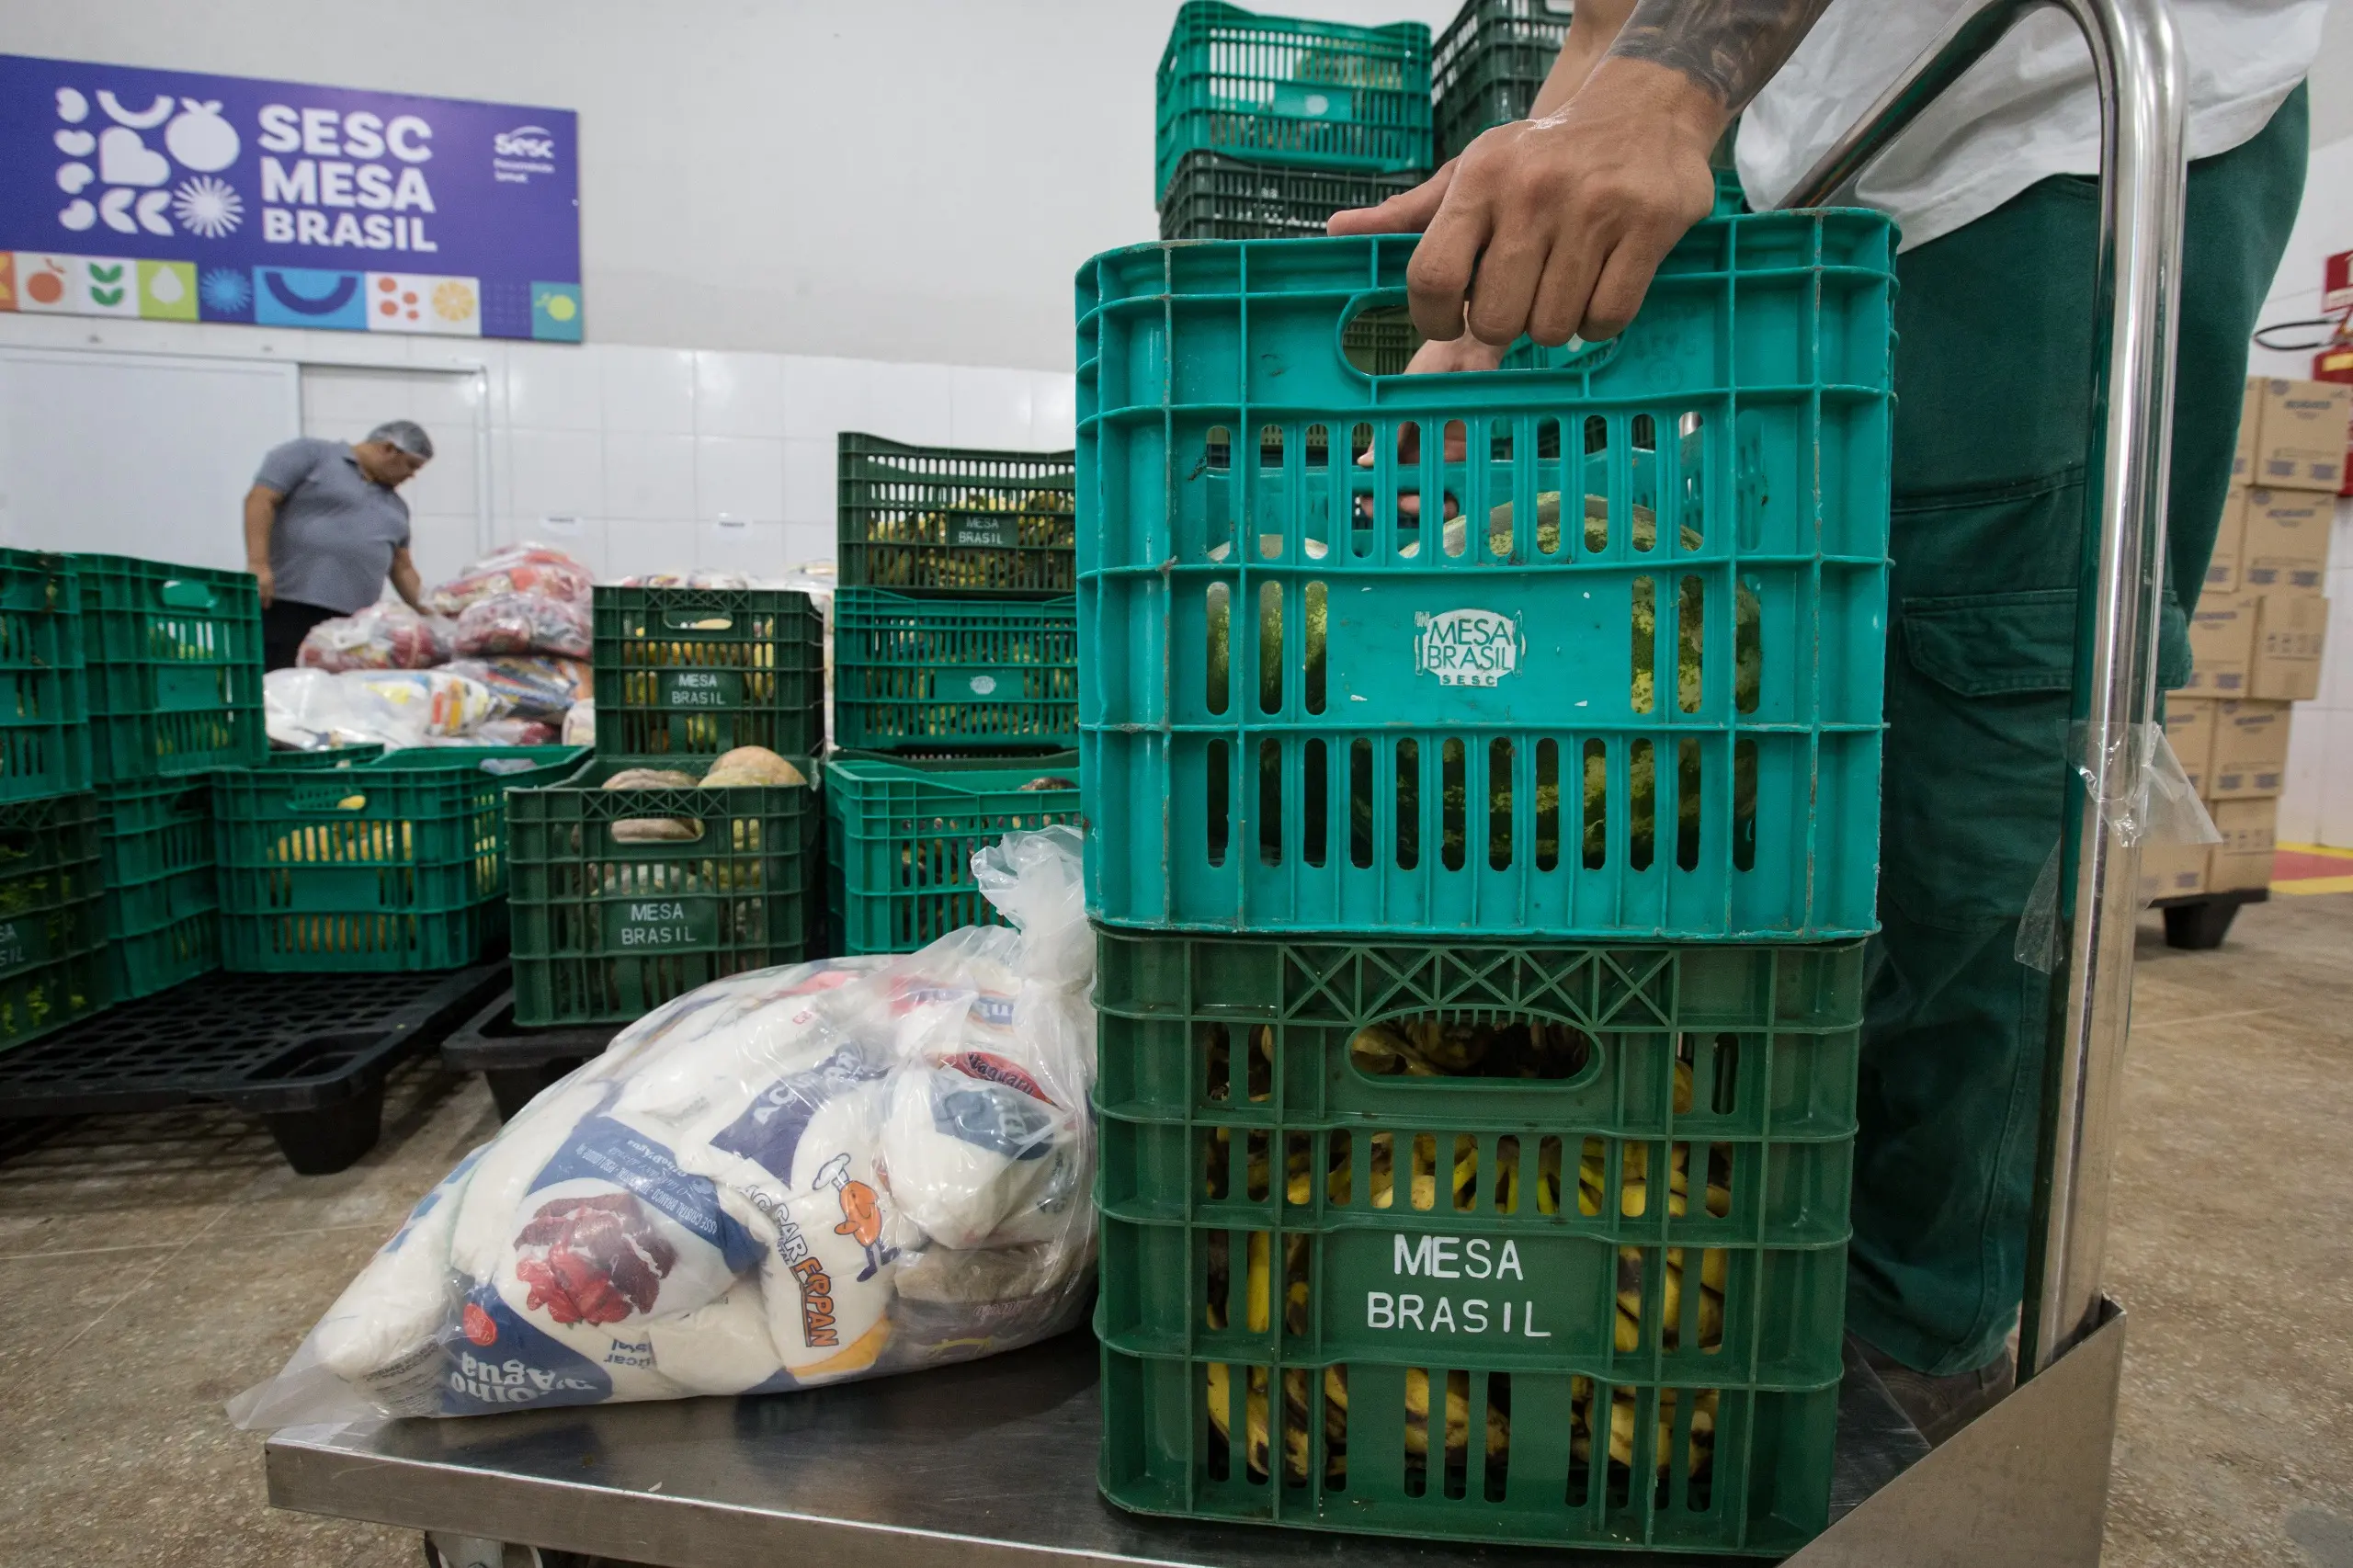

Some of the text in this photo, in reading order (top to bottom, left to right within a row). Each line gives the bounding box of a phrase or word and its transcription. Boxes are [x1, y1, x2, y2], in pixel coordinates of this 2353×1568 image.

[257, 104, 433, 164] SESC
[260, 156, 437, 213] MESA
[262, 207, 438, 253] BRASIL
[966, 517, 999, 528] MESA
[959, 531, 1004, 544] BRASIL
[1429, 619, 1511, 645] MESA
[1427, 644, 1511, 670] BRASIL
[678, 673, 718, 687] MESA
[1441, 675, 1495, 686] SESC
[672, 690, 726, 705] BRASIL
[631, 903, 684, 921] MESA
[621, 925, 697, 945] BRASIL
[651, 1190, 678, 1210] BRANCO
[676, 1203, 703, 1225] CRISTAL
[1394, 1233, 1524, 1281] MESA
[1368, 1290, 1552, 1337] BRASIL
